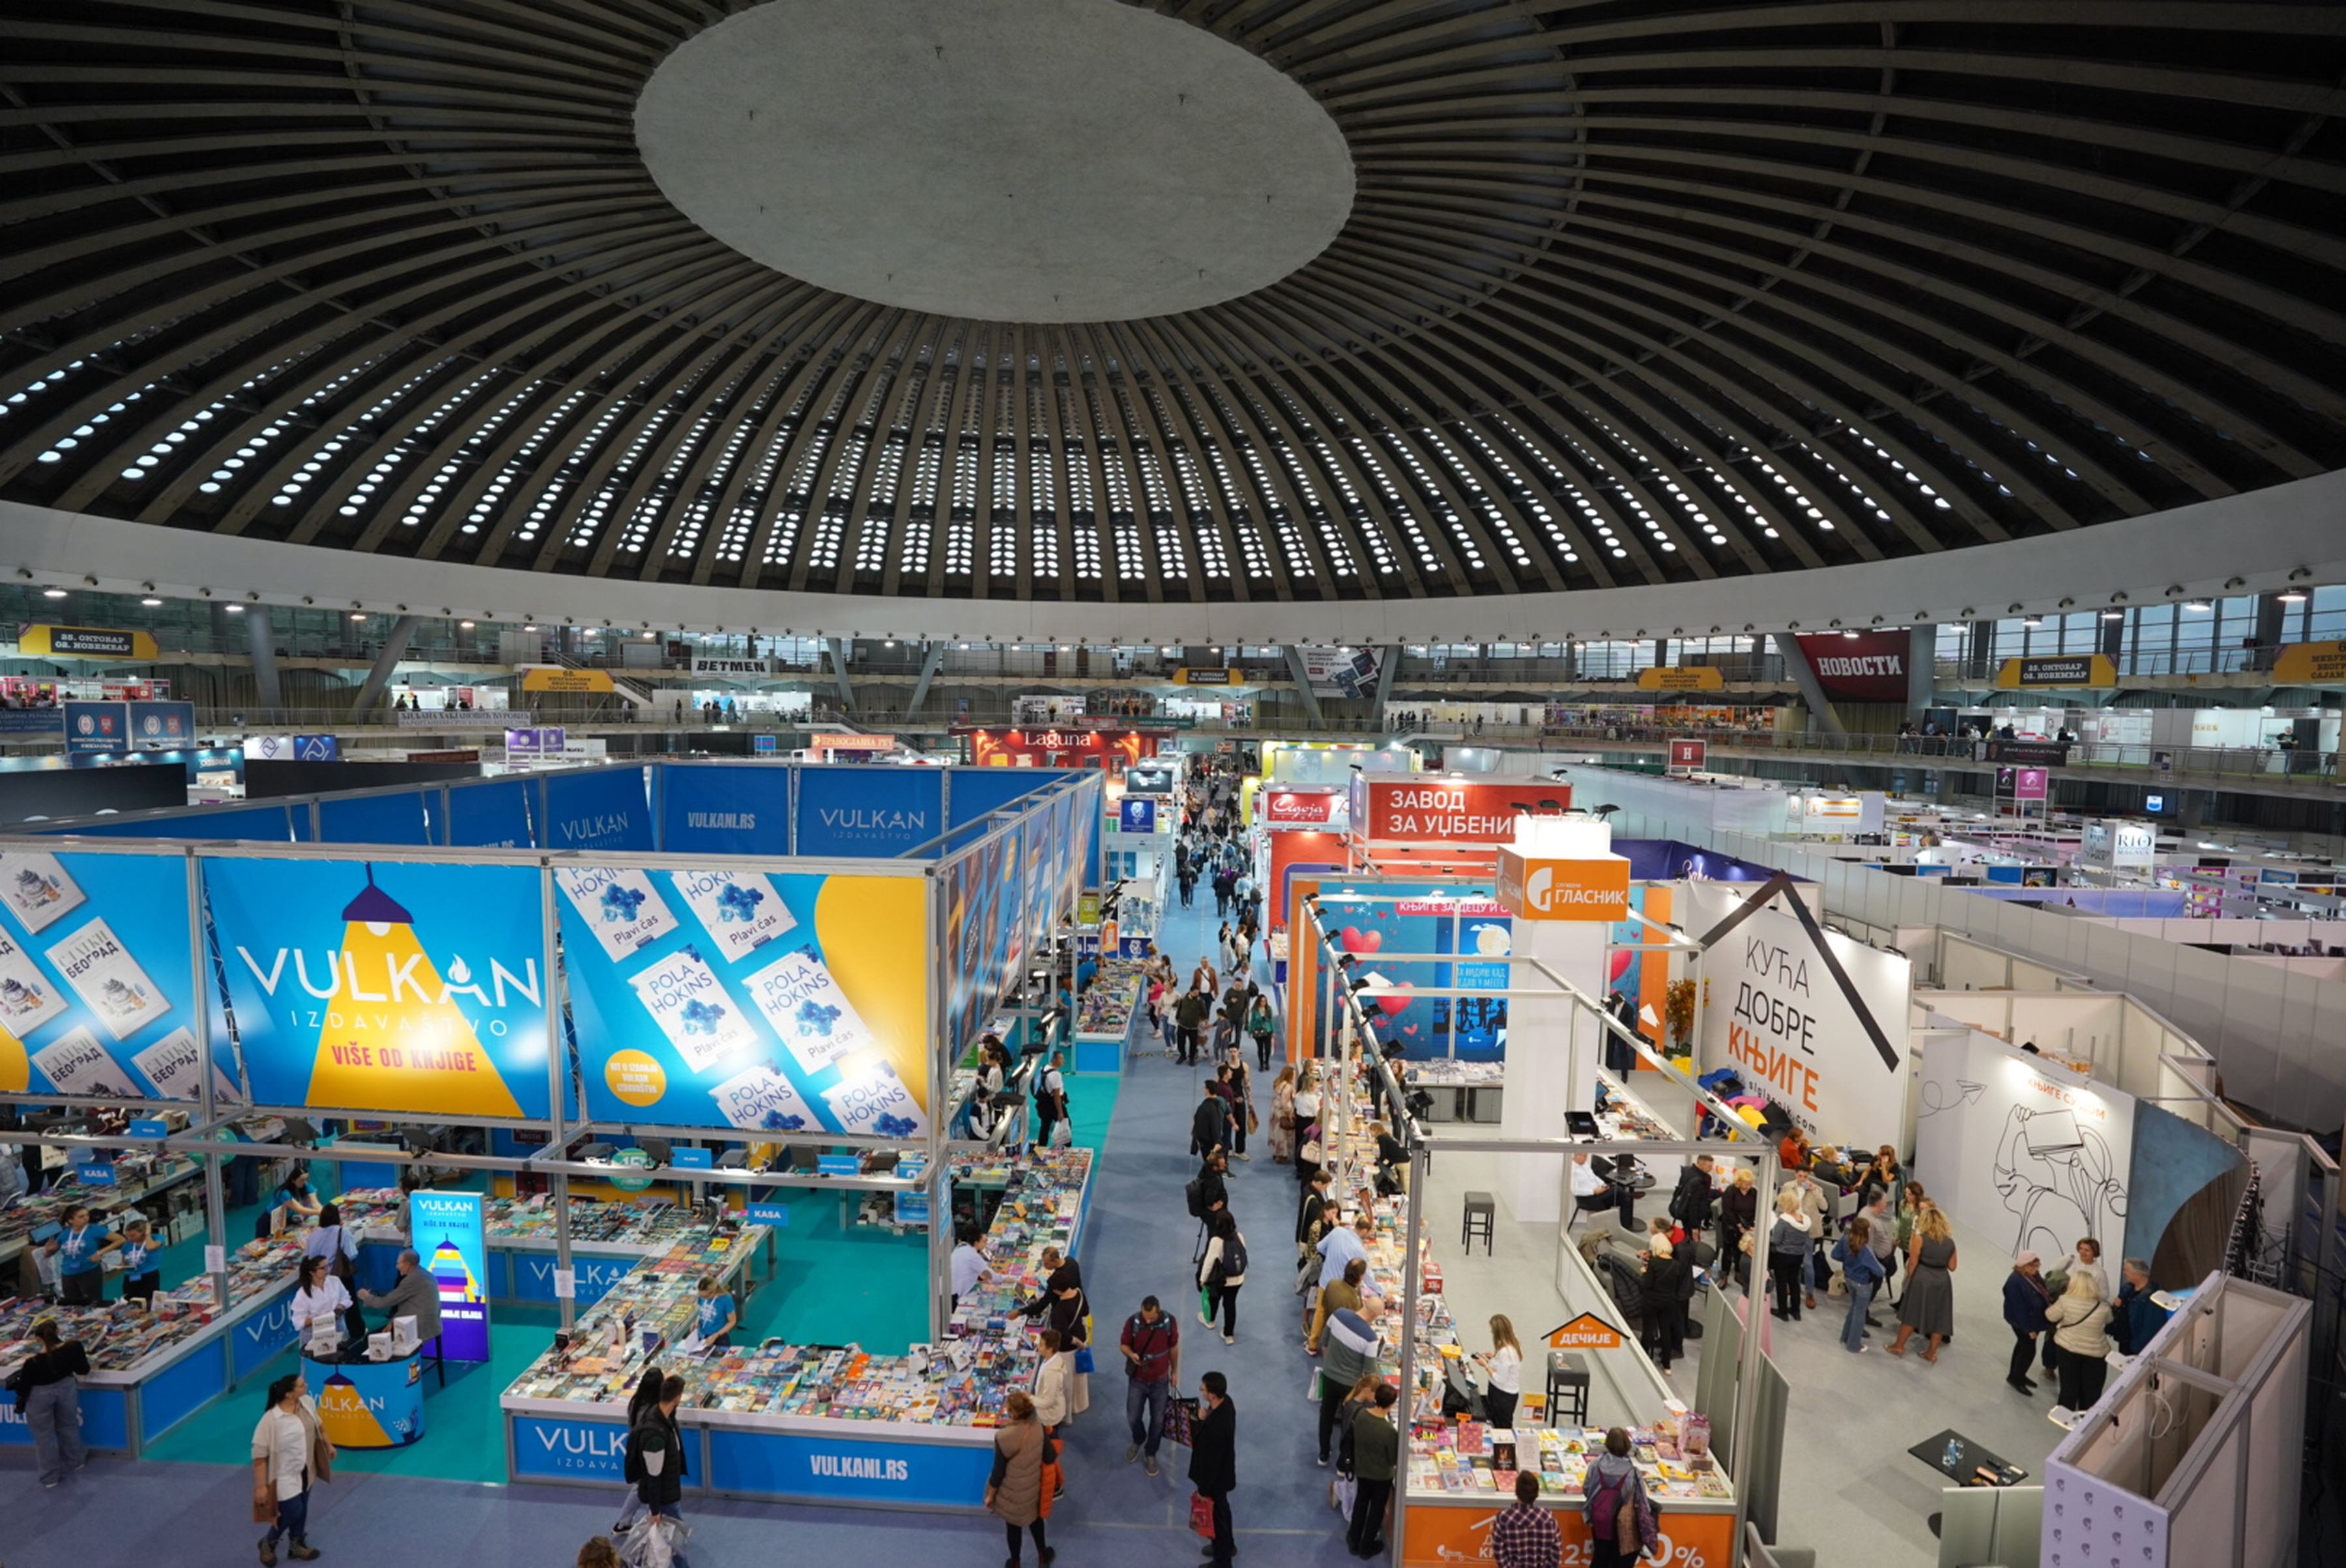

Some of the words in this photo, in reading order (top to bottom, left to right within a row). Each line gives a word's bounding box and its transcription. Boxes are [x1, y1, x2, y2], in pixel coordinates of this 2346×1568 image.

[697, 660, 766, 672] BETMEN
[1817, 655, 1903, 676] НОВОСТИ
[1024, 731, 1090, 748] Laguna
[1390, 790, 1466, 813] ЗАВОД
[561, 811, 628, 841] VULKAN
[688, 812, 755, 830] VULKANI.RS
[819, 809, 925, 830] VULKAN
[1389, 815, 1418, 833] ЗА
[1423, 815, 1516, 837] УЏБЕНИ
[2118, 834, 2152, 847] RIO
[1400, 903, 1438, 911] КЊИГЕ
[1556, 889, 1625, 904] ГЛАСНИК
[614, 926, 641, 944] Plavi
[641, 915, 659, 931] čas
[730, 926, 757, 945] Plavi
[758, 915, 777, 931] čas
[66, 940, 119, 979] БЕОГРАД
[1746, 935, 1810, 998] КУЋА
[236, 946, 542, 1008] VULKAN
[649, 964, 694, 995] POLA
[764, 964, 811, 996] POLA
[652, 975, 712, 1015] HOKINS
[766, 975, 830, 1016] HOKINS
[291, 1010, 508, 1036] IZDAVAŠTVO
[1735, 981, 1816, 1056] ДОБРЕ
[331, 1041, 373, 1066] VIŠE
[379, 1049, 403, 1068] OD
[411, 1049, 476, 1071] KNJIGE
[693, 1037, 719, 1057] Plavi
[807, 1038, 835, 1059] Plavi
[51, 1047, 103, 1083] БЕОГРАД
[1729, 1021, 1819, 1112] КЊИГЕ
[729, 1077, 774, 1106] POLA
[731, 1086, 792, 1124] HOKINS
[842, 1078, 888, 1108] POLA
[843, 1087, 906, 1126] HOKINS
[418, 1200, 473, 1212] VULKAN
[755, 1210, 781, 1219] KASA
[530, 1262, 630, 1285] VLKA
[1559, 1333, 1612, 1345] ДЕЧИЈЕ
[535, 1427, 629, 1456] VULK
[557, 1458, 618, 1470] IZDAVA
[810, 1454, 908, 1480] VULKANI.RS
